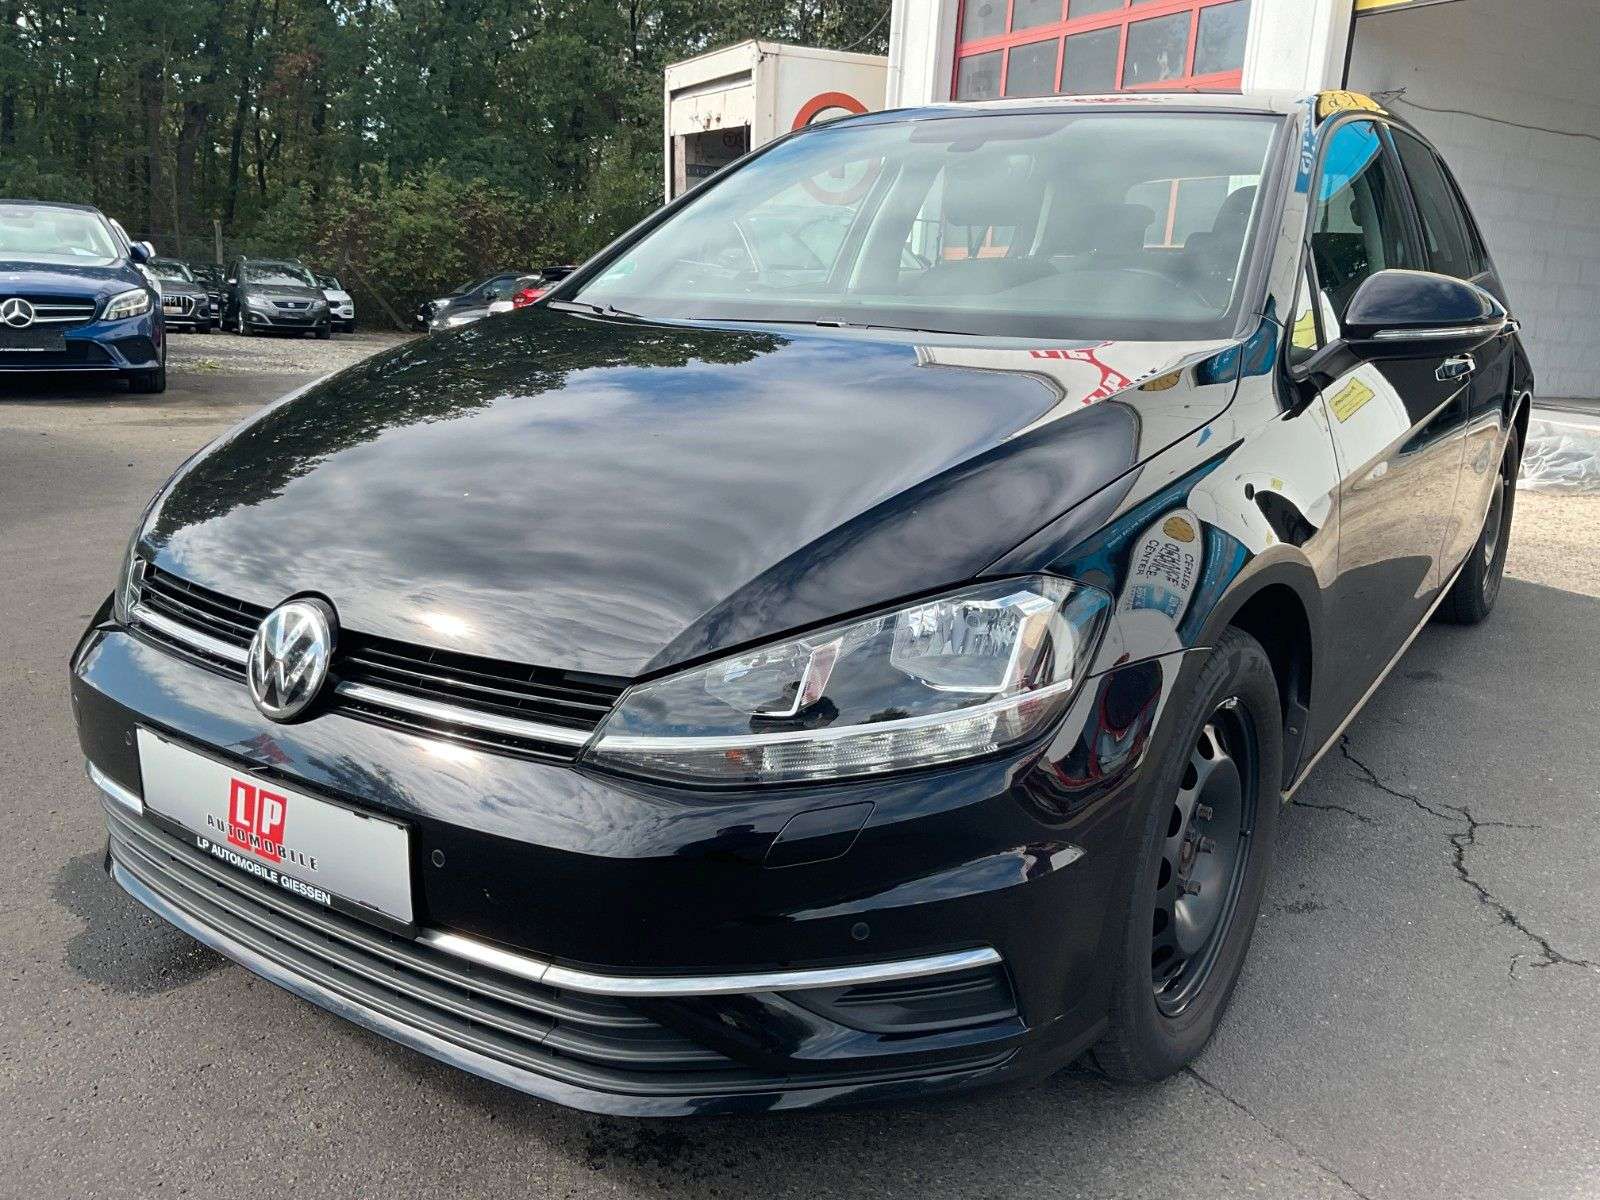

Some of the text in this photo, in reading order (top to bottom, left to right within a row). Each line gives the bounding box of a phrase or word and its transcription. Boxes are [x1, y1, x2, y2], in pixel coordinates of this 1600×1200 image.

[235, 786, 283, 835] LP
[196, 835, 331, 905] LP AUTOMOBILE GIESSEN
[206, 813, 319, 872] AUTOMOBILE
